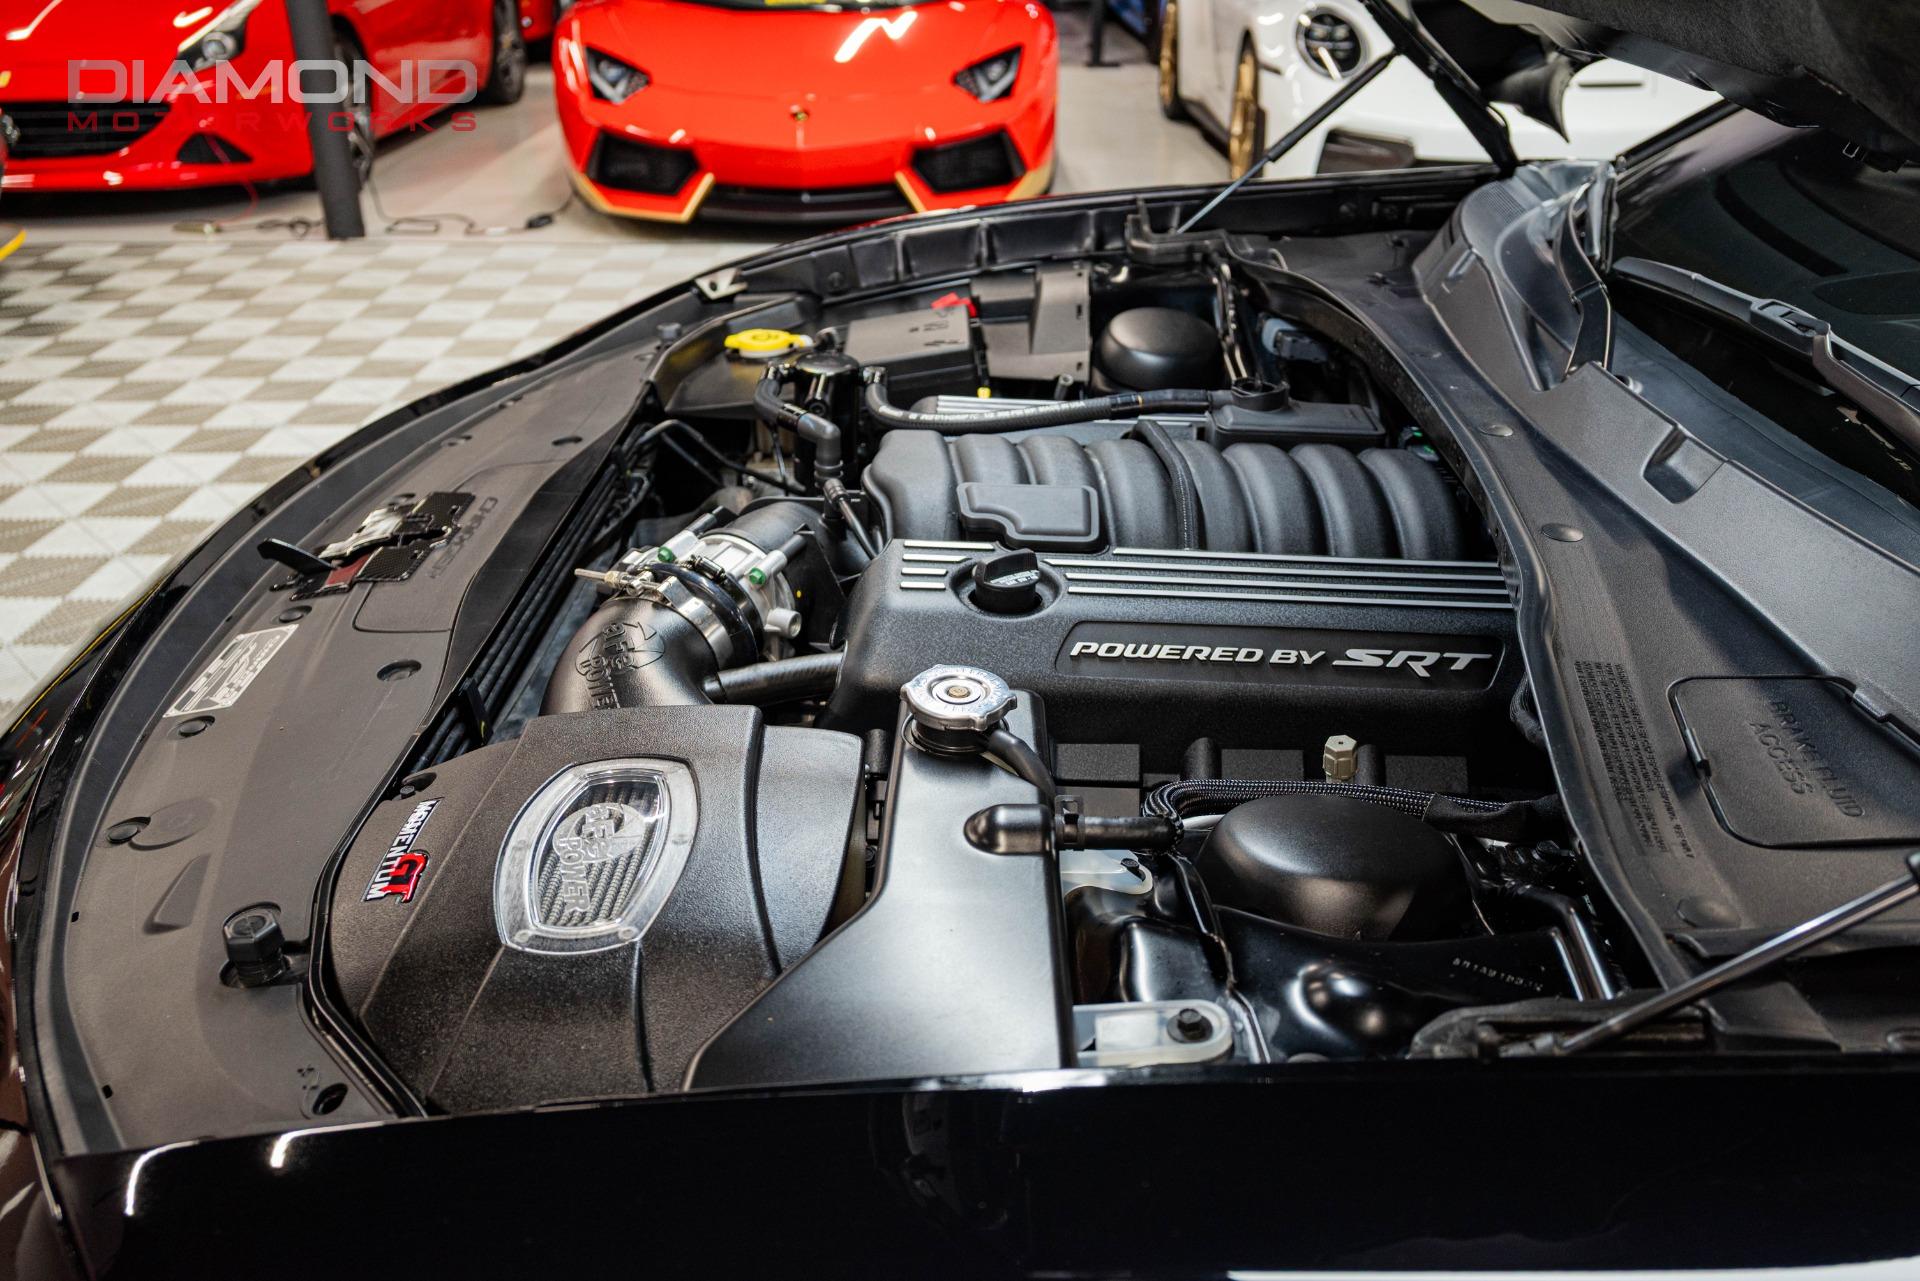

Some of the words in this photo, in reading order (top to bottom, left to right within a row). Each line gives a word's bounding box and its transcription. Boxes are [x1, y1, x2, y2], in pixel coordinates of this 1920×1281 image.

[1069, 641, 1263, 664] POWERED
[1268, 648, 1327, 666] BY
[1332, 648, 1493, 678] SRT
[1749, 722, 1815, 794] ACCESS
[1809, 766, 1865, 817] FLUID
[365, 799, 441, 901] MOMENTUM
[381, 850, 429, 903] GT
